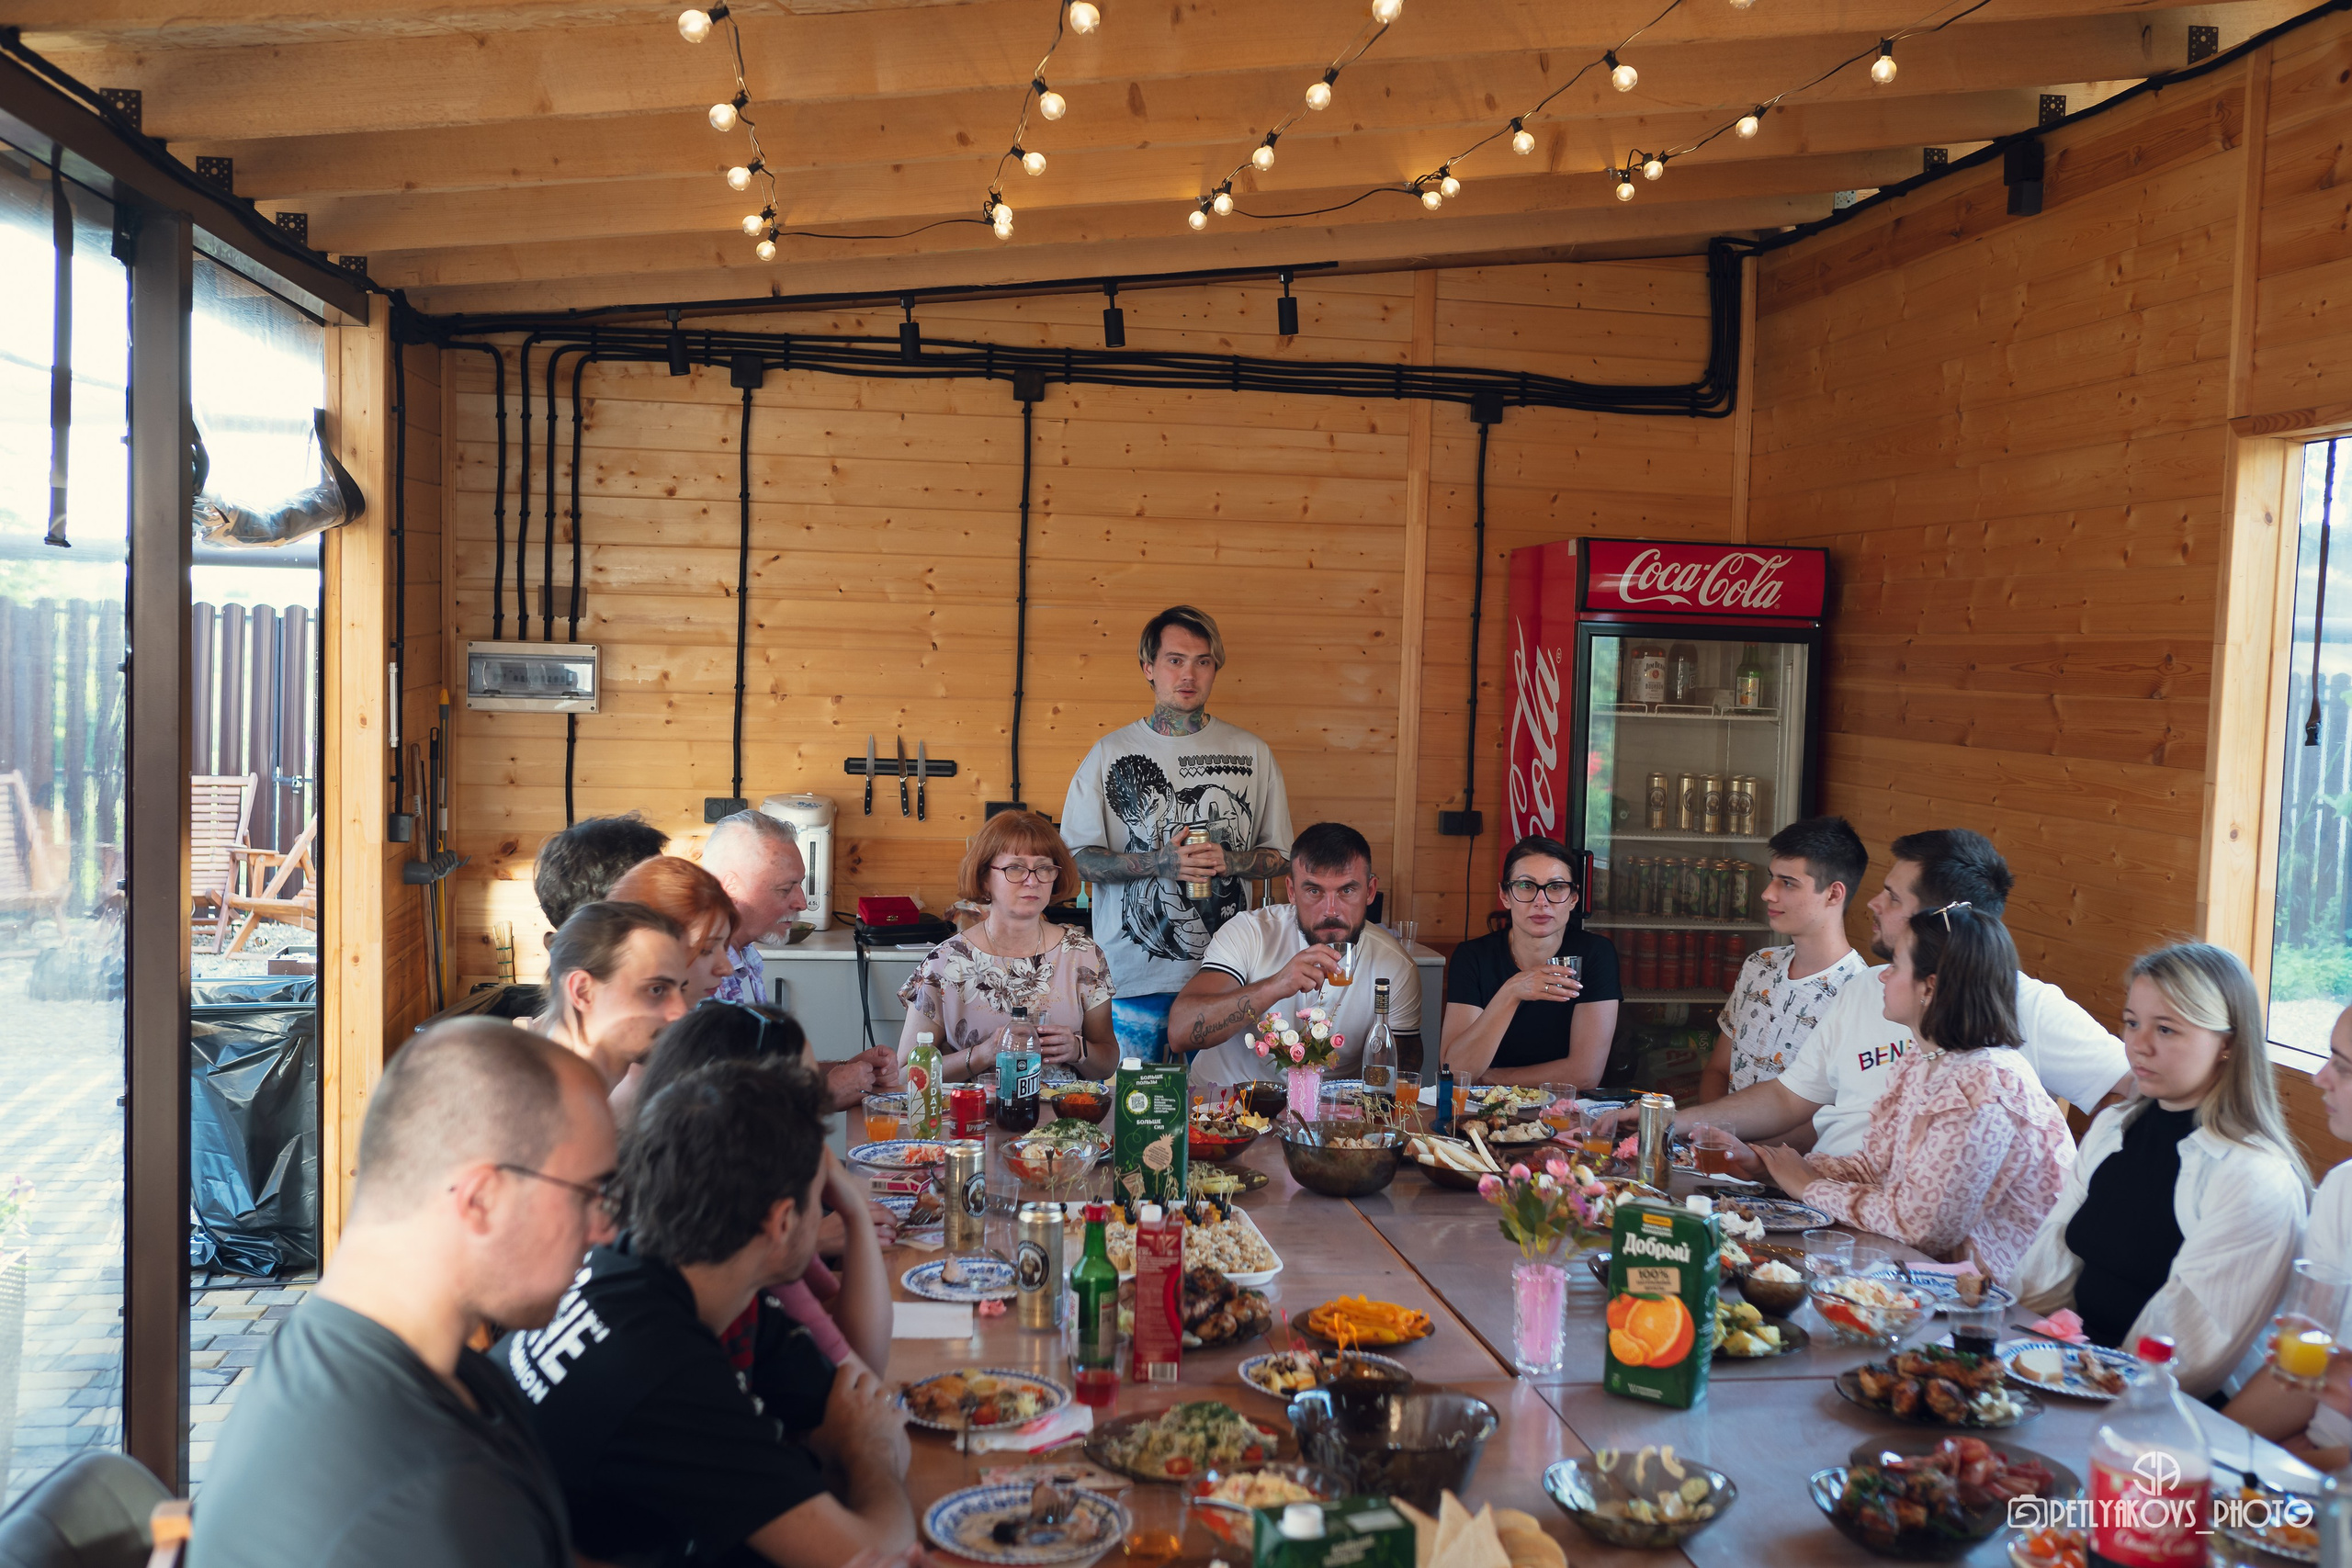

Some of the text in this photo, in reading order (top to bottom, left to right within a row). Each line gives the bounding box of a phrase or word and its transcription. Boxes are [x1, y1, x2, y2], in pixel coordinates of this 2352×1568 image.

[1619, 547, 1793, 609] Coca-Cola
[1622, 1231, 1691, 1264] Добрый
[1638, 1268, 1669, 1279] 100%
